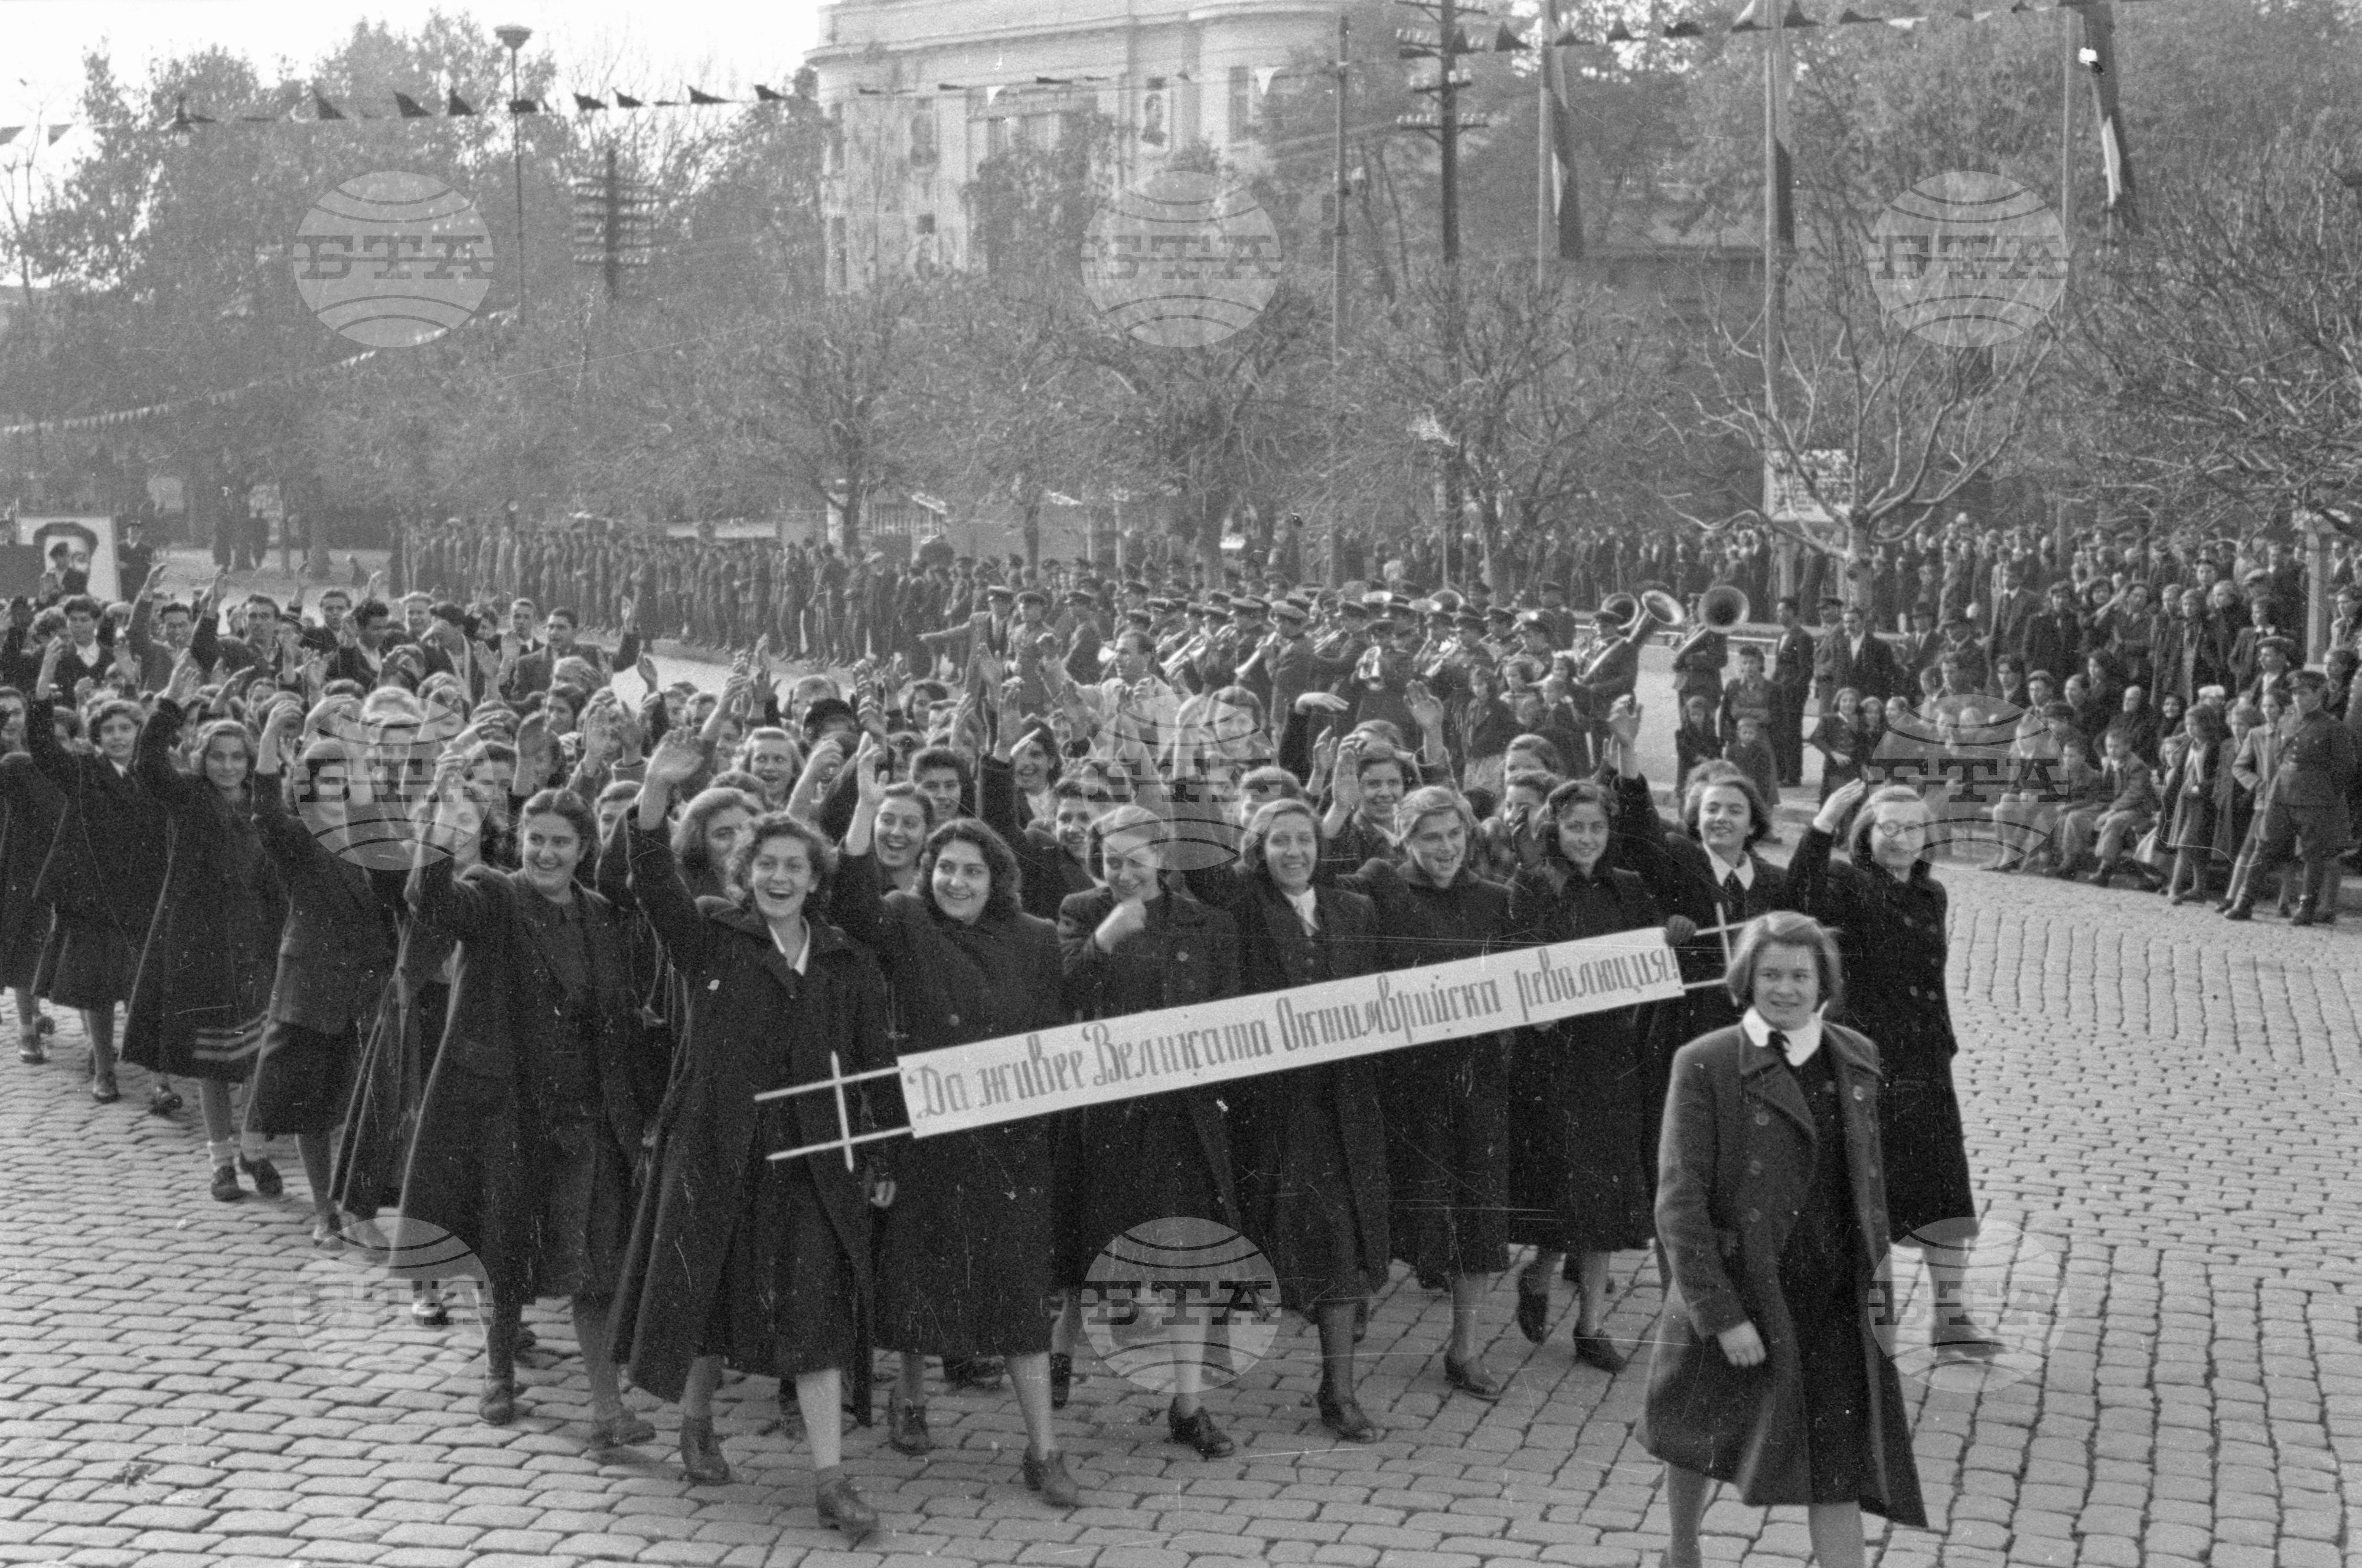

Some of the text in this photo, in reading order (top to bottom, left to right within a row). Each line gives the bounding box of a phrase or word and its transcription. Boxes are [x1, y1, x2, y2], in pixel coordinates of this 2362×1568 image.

[908, 946, 1680, 1119] Да живее Великата Октомврийска революция!
